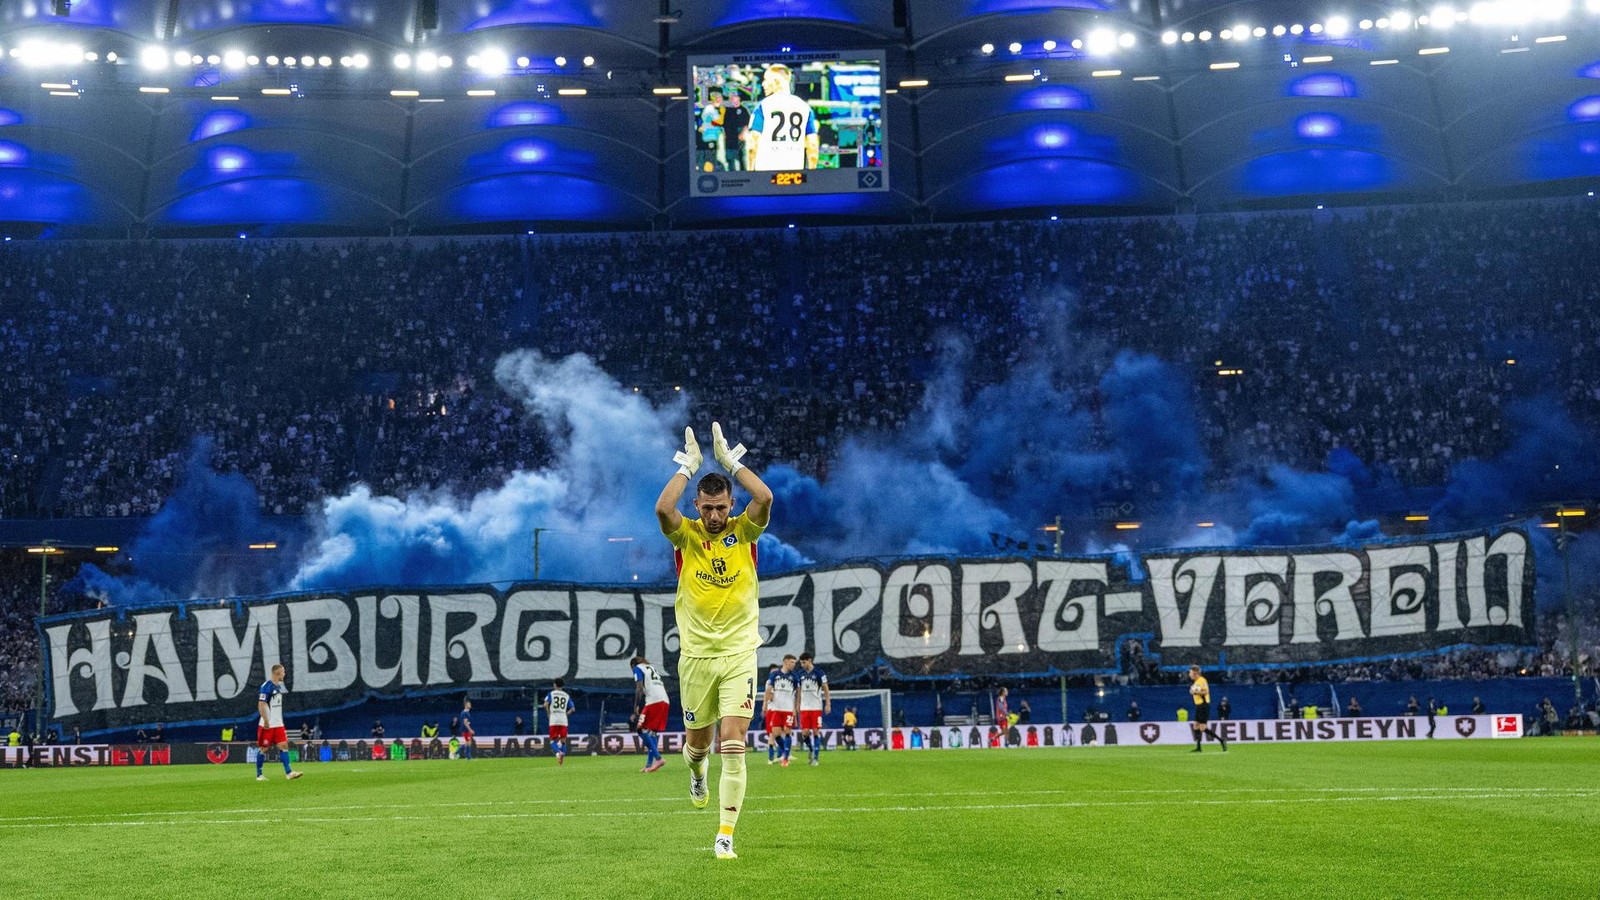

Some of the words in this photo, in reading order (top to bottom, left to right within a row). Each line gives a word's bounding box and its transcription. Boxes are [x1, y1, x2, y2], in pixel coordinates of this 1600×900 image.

[770, 111, 804, 142] 28
[747, 677, 754, 699] 1
[553, 696, 567, 710] 38
